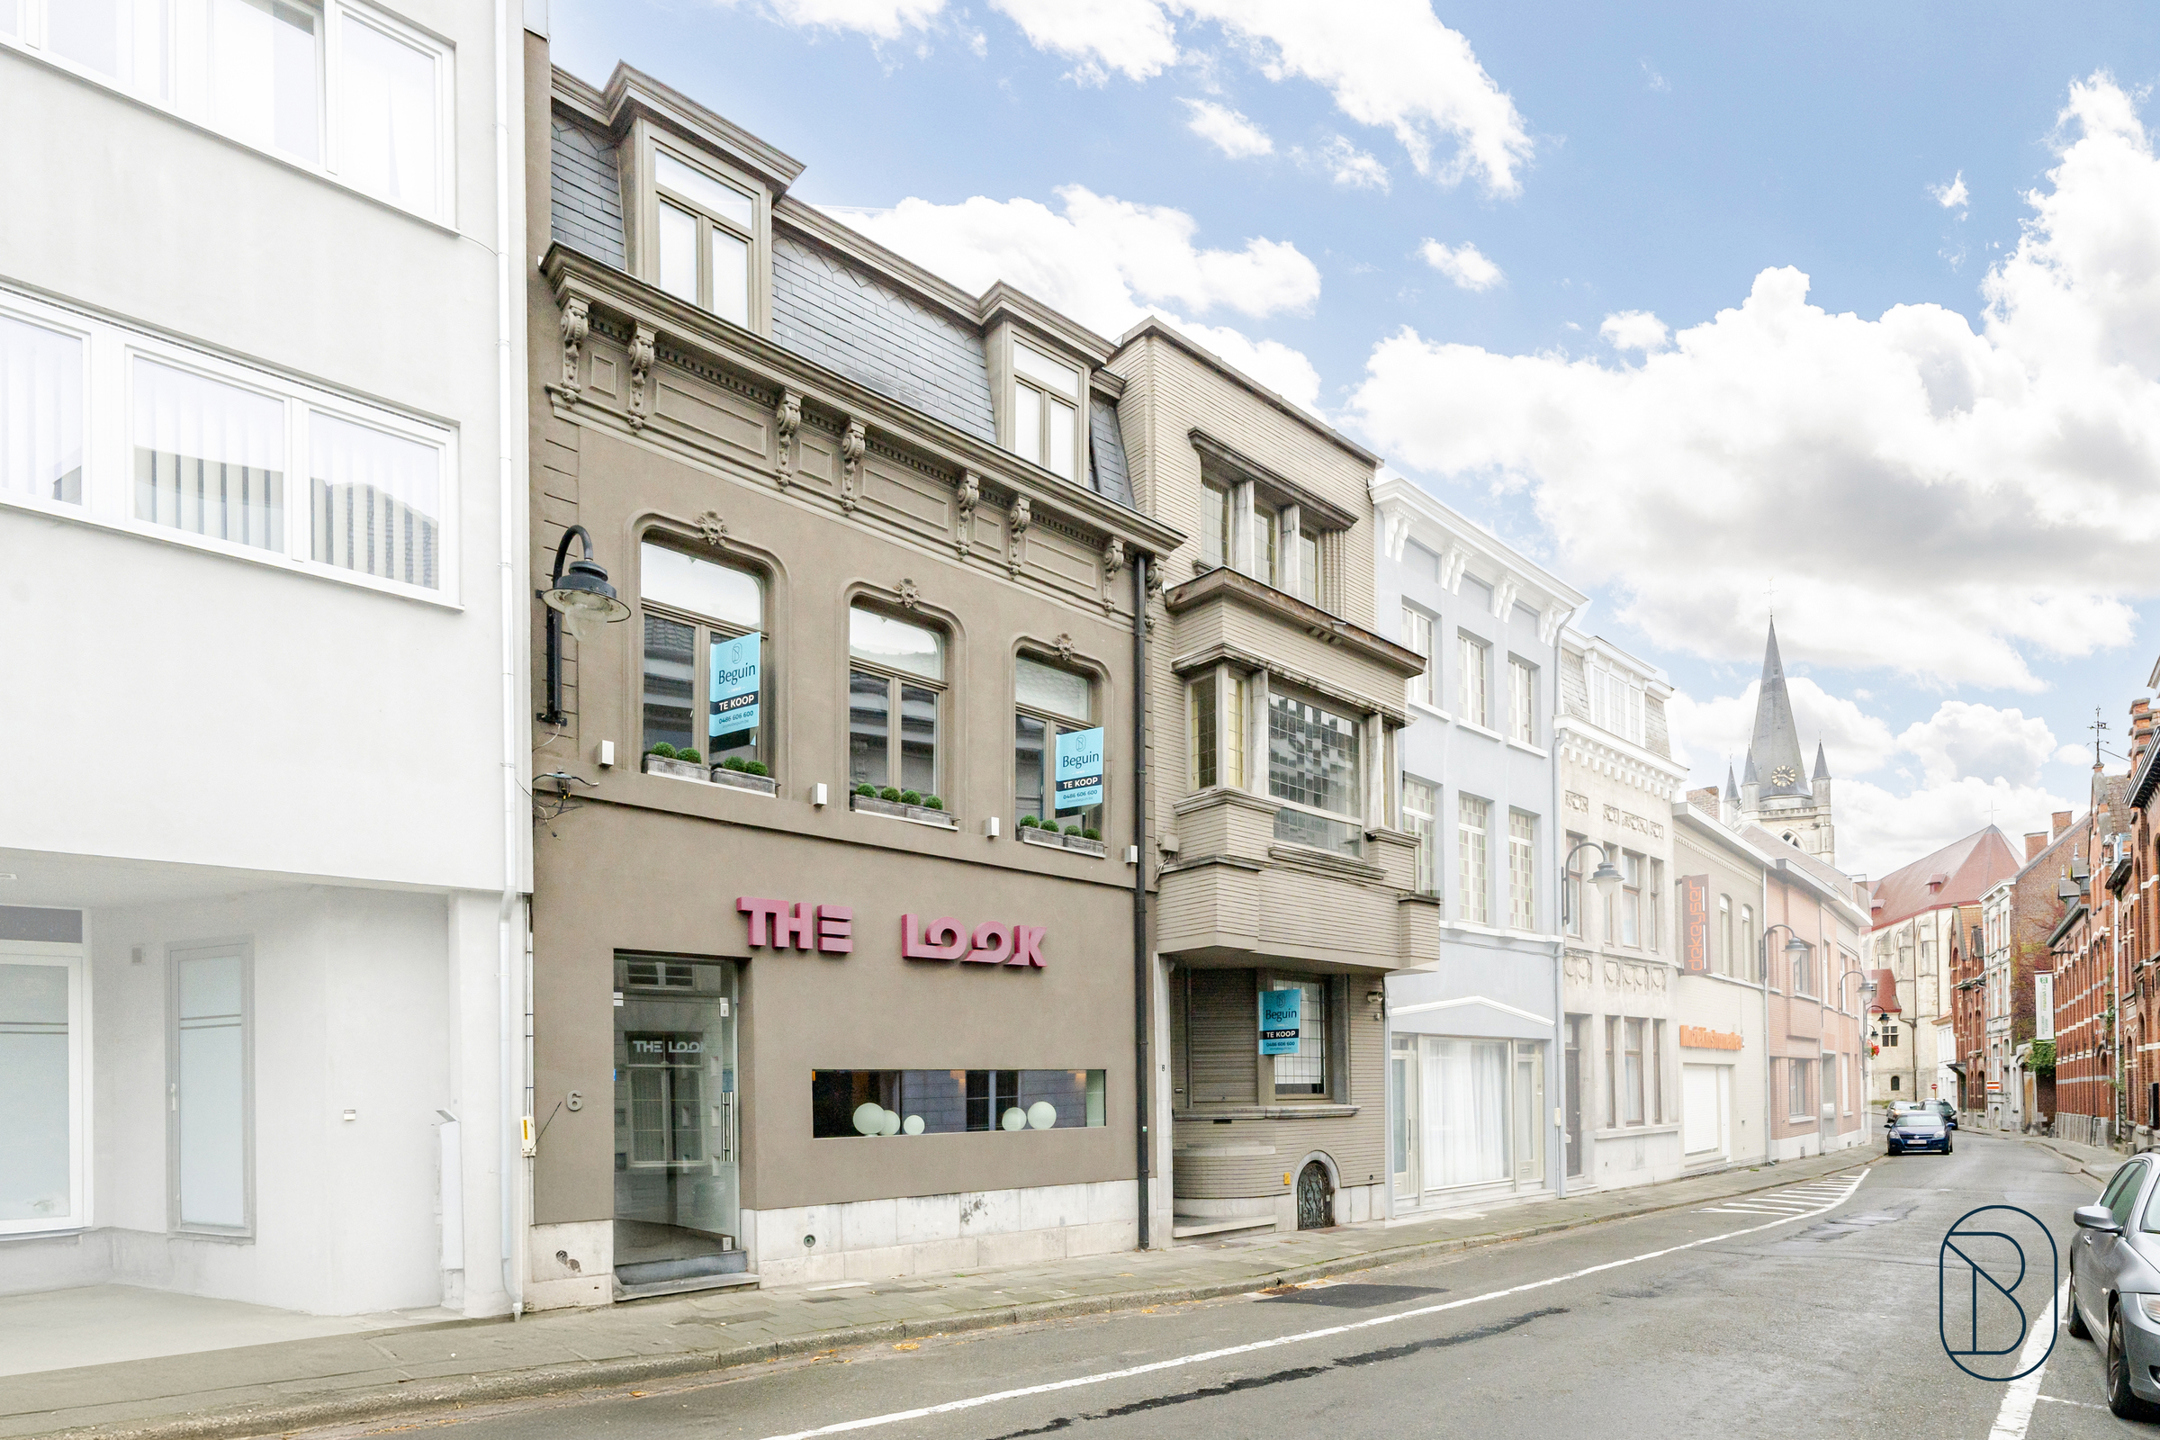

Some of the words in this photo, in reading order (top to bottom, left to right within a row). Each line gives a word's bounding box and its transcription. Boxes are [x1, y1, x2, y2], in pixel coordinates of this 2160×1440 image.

[718, 662, 756, 686] Beguin
[719, 700, 729, 711] TE
[730, 694, 755, 708] KOOP
[743, 710, 754, 718] 600
[1063, 751, 1100, 769] Beguin
[1063, 781, 1073, 789] TE
[1074, 776, 1098, 787] KOOP
[736, 896, 853, 954] THE
[901, 913, 1048, 968] LOOK
[1687, 880, 1706, 971] dekeyser
[1265, 1008, 1297, 1022] Beguin
[1275, 1030, 1296, 1038] KOOP
[632, 1040, 663, 1053] THE
[566, 1090, 583, 1112] 6
